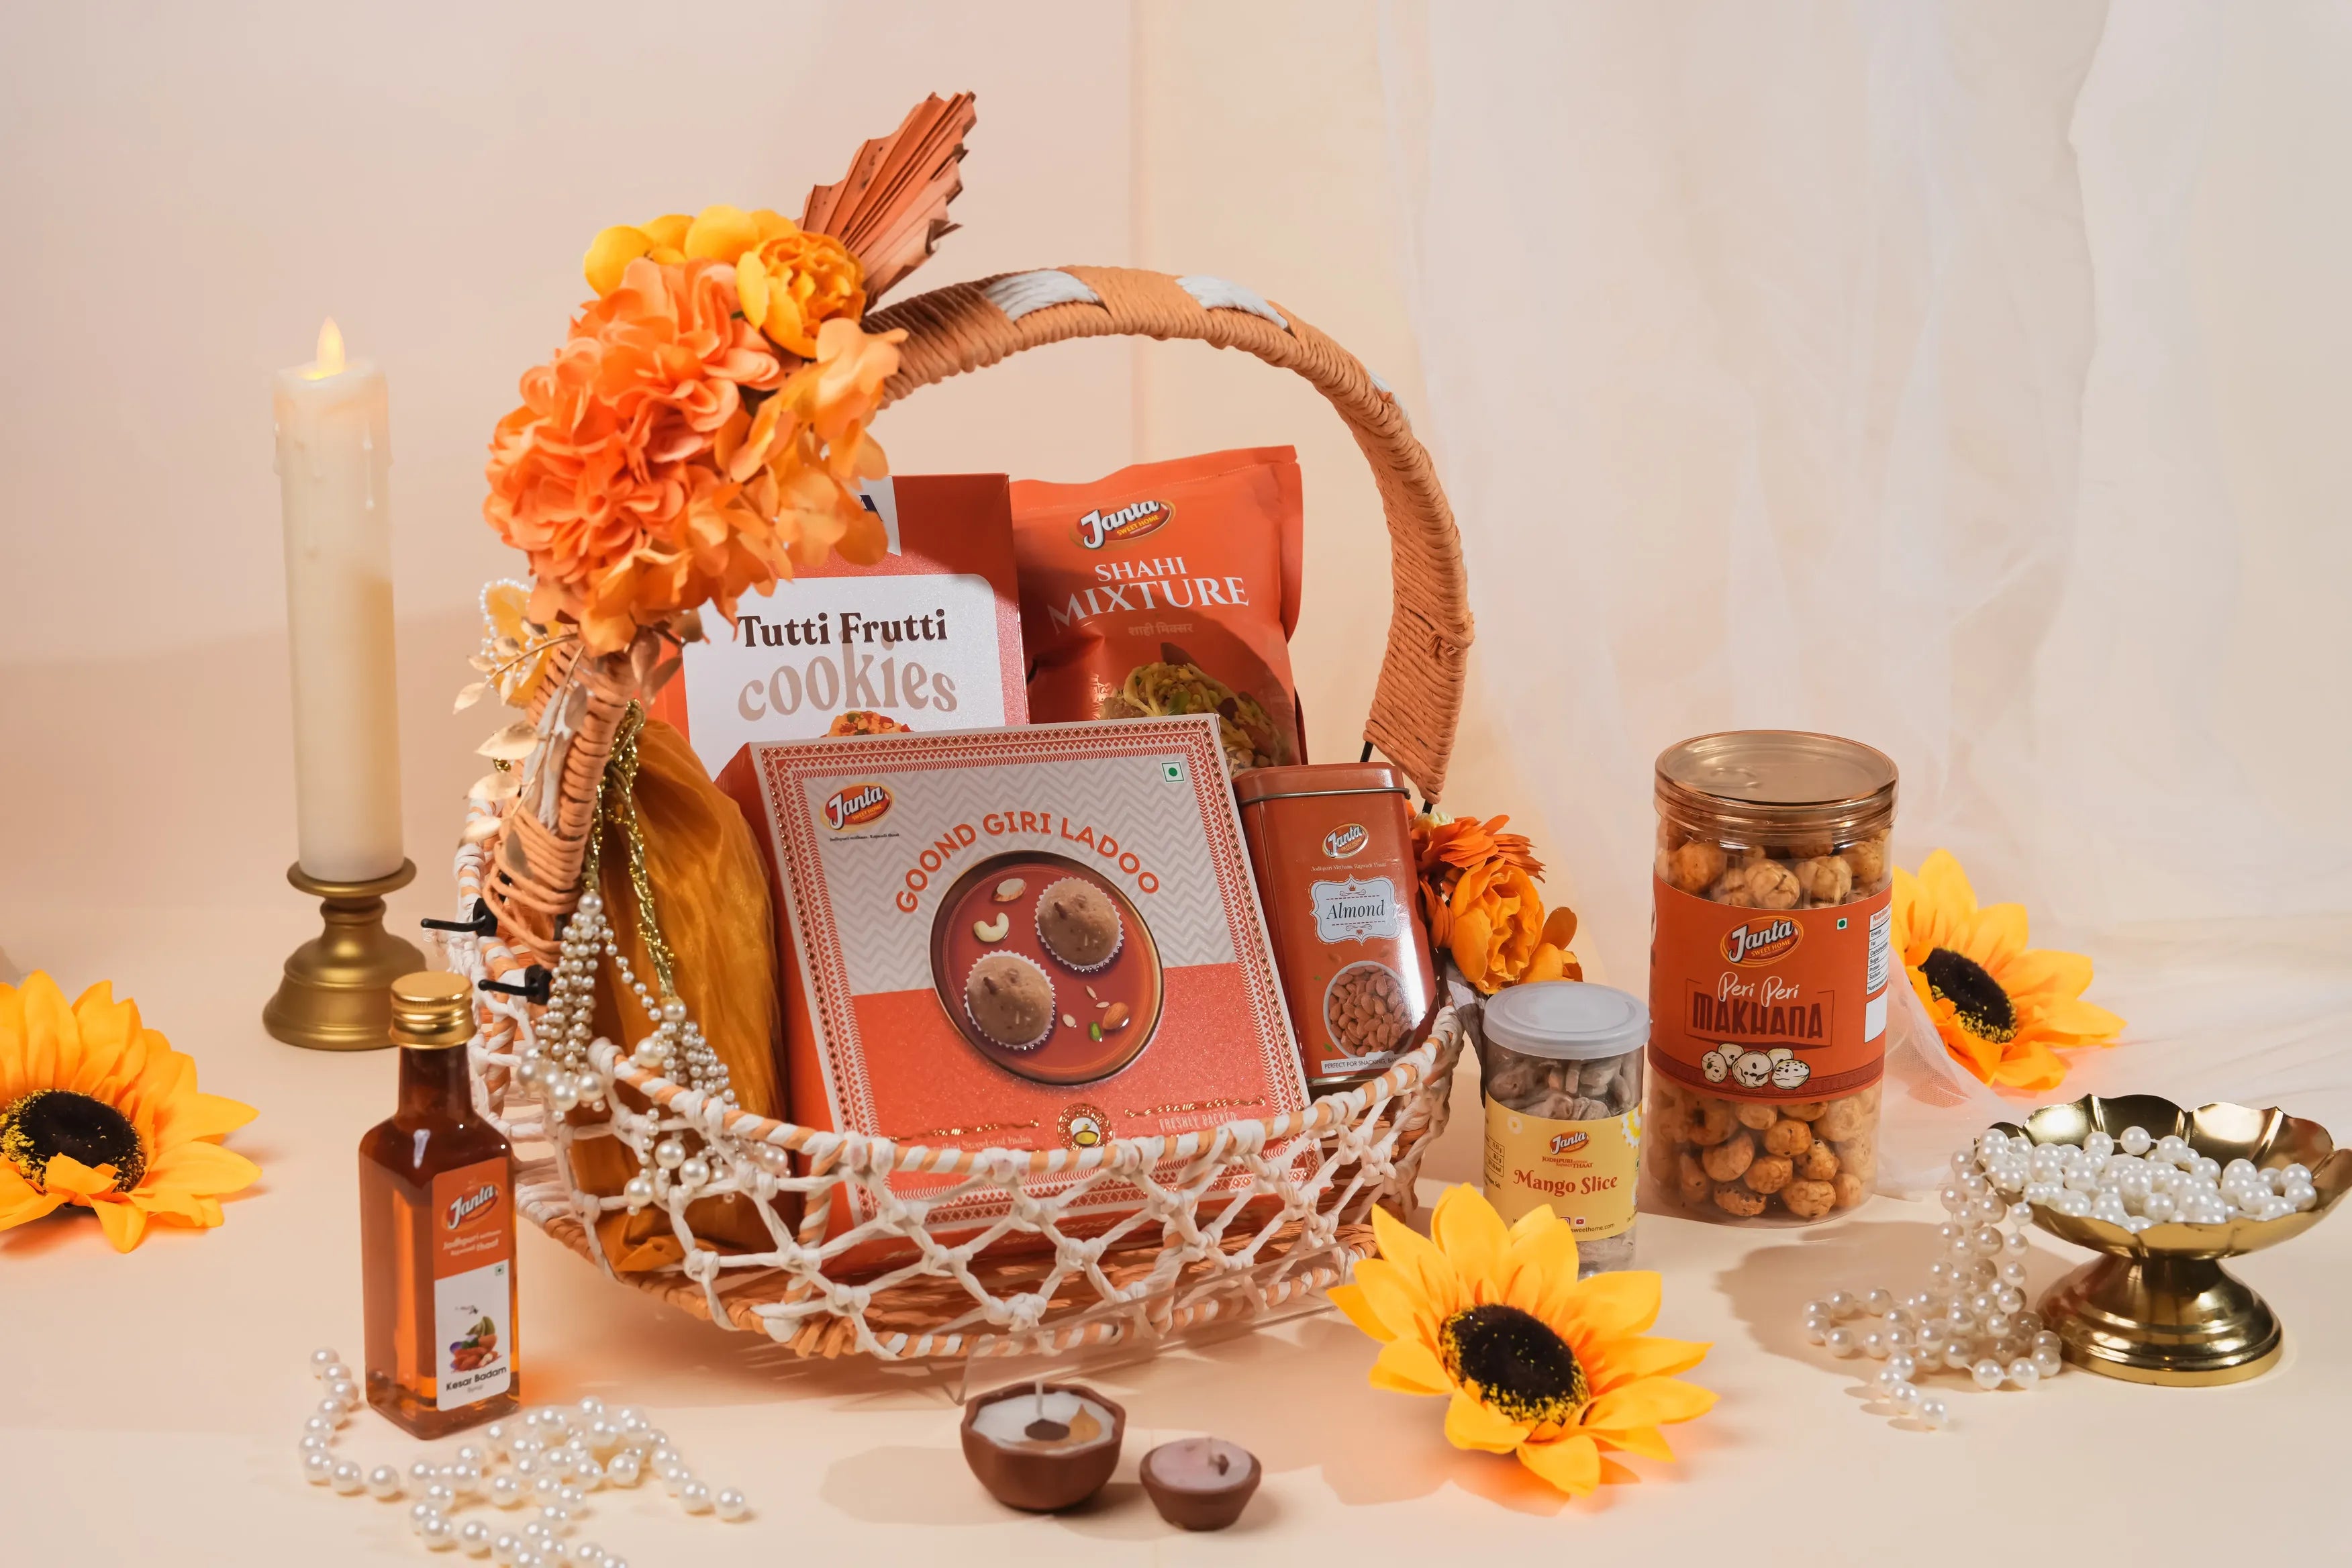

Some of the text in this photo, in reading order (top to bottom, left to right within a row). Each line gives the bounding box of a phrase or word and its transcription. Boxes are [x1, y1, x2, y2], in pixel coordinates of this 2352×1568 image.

[1080, 500, 1160, 548] Janta
[1116, 524, 1138, 536] SWEET
[1138, 514, 1160, 528] HOME
[1095, 556, 1187, 581] SHAHI
[1047, 577, 1249, 635] MIXTURE
[736, 608, 948, 648] Tutti Frutti
[738, 630, 958, 722] cookies
[828, 785, 884, 830] Janta
[1327, 826, 1363, 858] Janta
[895, 811, 1160, 914] GOOND GIRI LADOO
[1326, 899, 1385, 920] Almond
[1728, 920, 1795, 963] Janta
[1751, 947, 1771, 957] SWEET
[1771, 939, 1792, 950] HOME
[1718, 971, 1800, 1008] Peri Peri
[1692, 991, 1823, 1039] MAKHANA
[1159, 1110, 1238, 1132] FRESHLY PACKED
[1551, 1131, 1587, 1155] Janta
[1513, 1169, 1576, 1197] Mango
[1581, 1176, 1618, 1195] Slice
[448, 1185, 495, 1230] Janta
[446, 1367, 507, 1391] Kesar Badam
